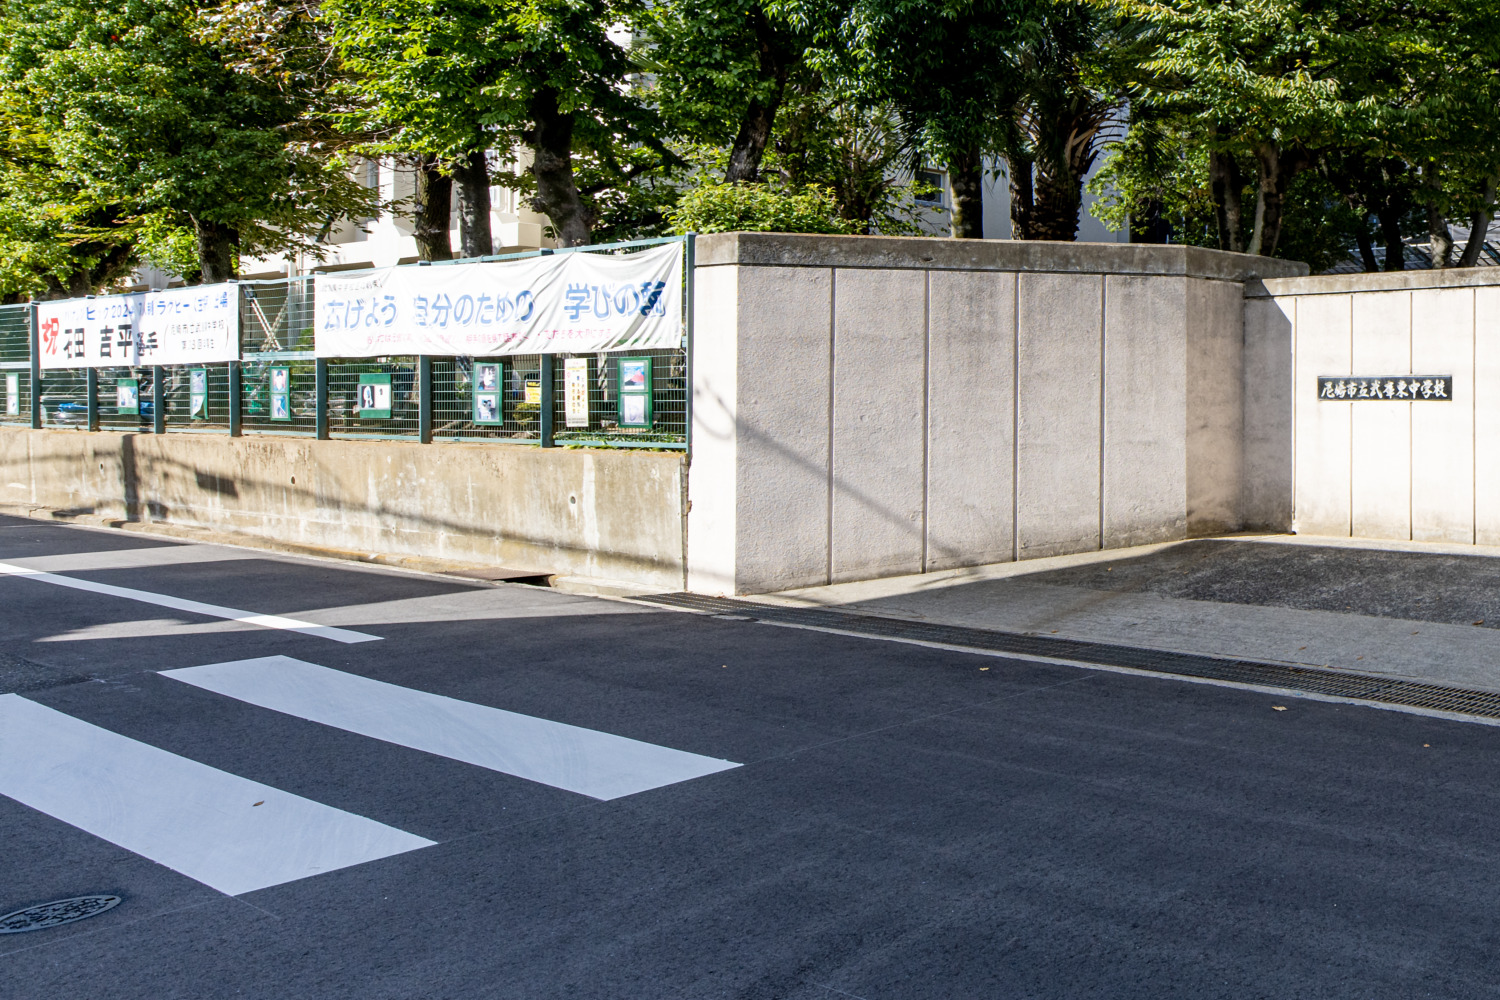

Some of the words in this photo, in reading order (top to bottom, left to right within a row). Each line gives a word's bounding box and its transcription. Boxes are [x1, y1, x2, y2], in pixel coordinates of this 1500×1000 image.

[323, 295, 397, 329] 広げよう
[41, 317, 59, 356] 祝
[1320, 379, 1448, 399] 尼崎市立武庫東中学校
